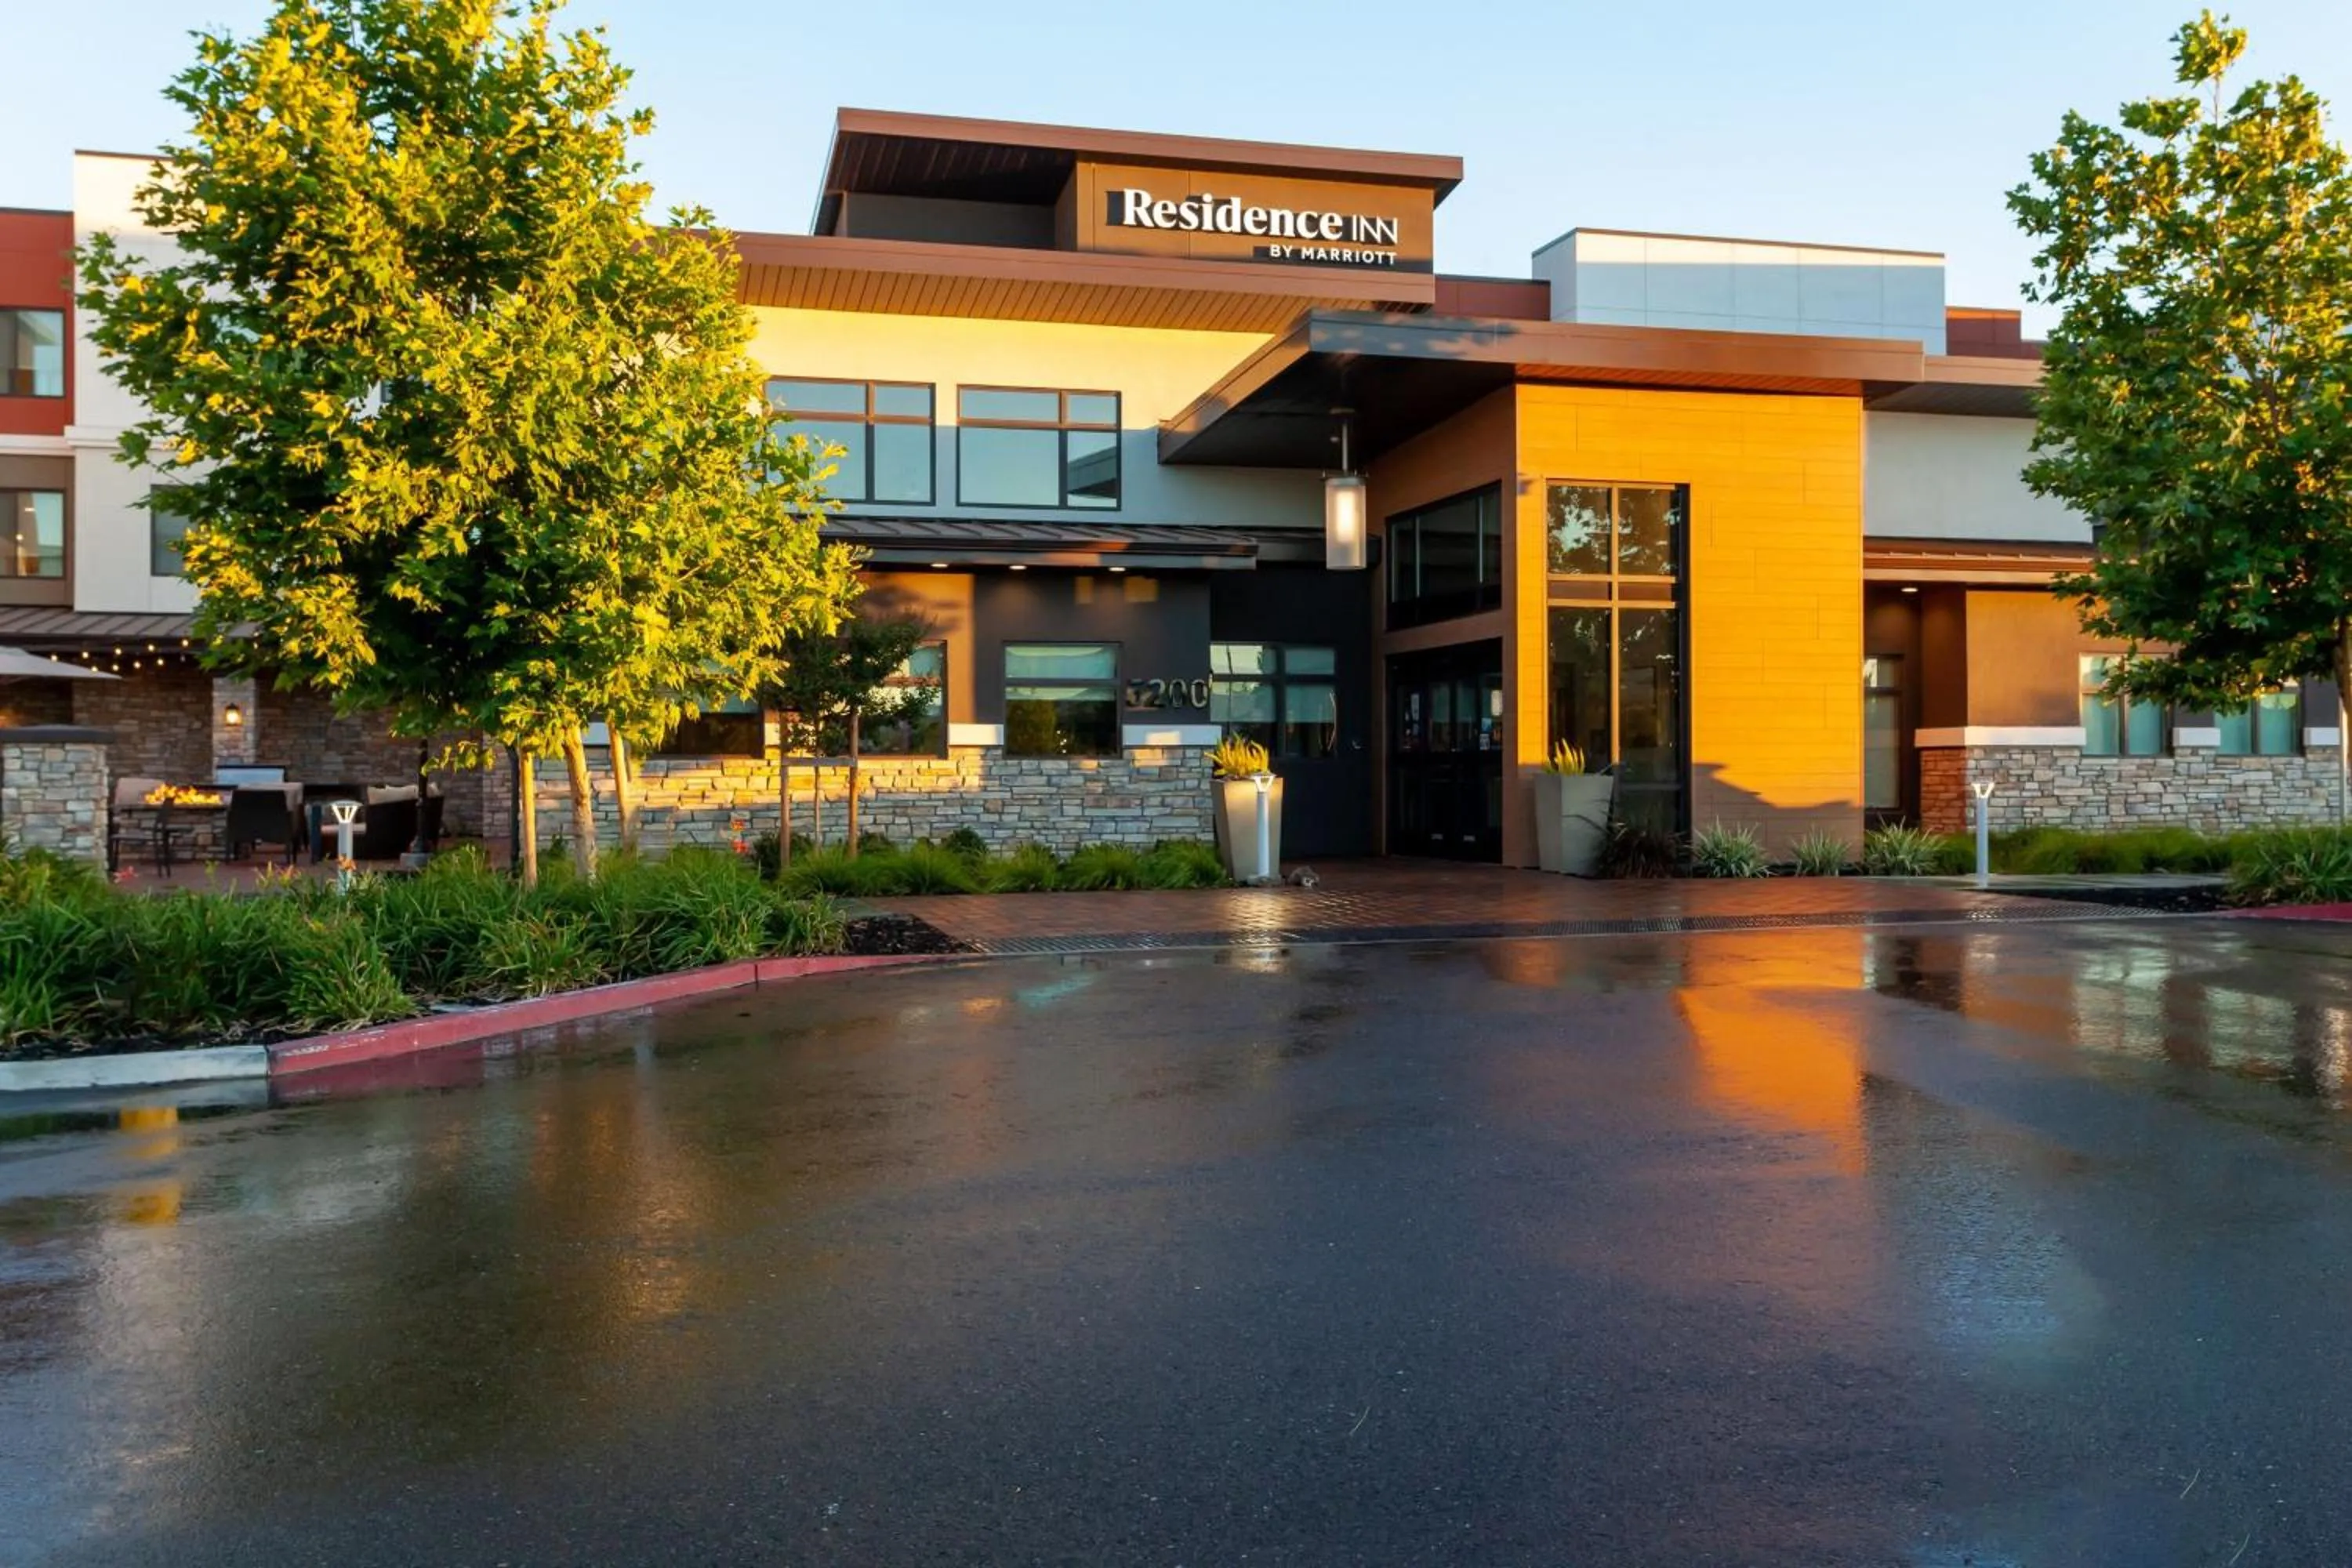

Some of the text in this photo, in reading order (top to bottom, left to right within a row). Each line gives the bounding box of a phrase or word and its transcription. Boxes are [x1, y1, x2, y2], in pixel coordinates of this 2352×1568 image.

[1123, 188, 1398, 244] Residence INN
[1270, 245, 1398, 265] BY MARRIOTT
